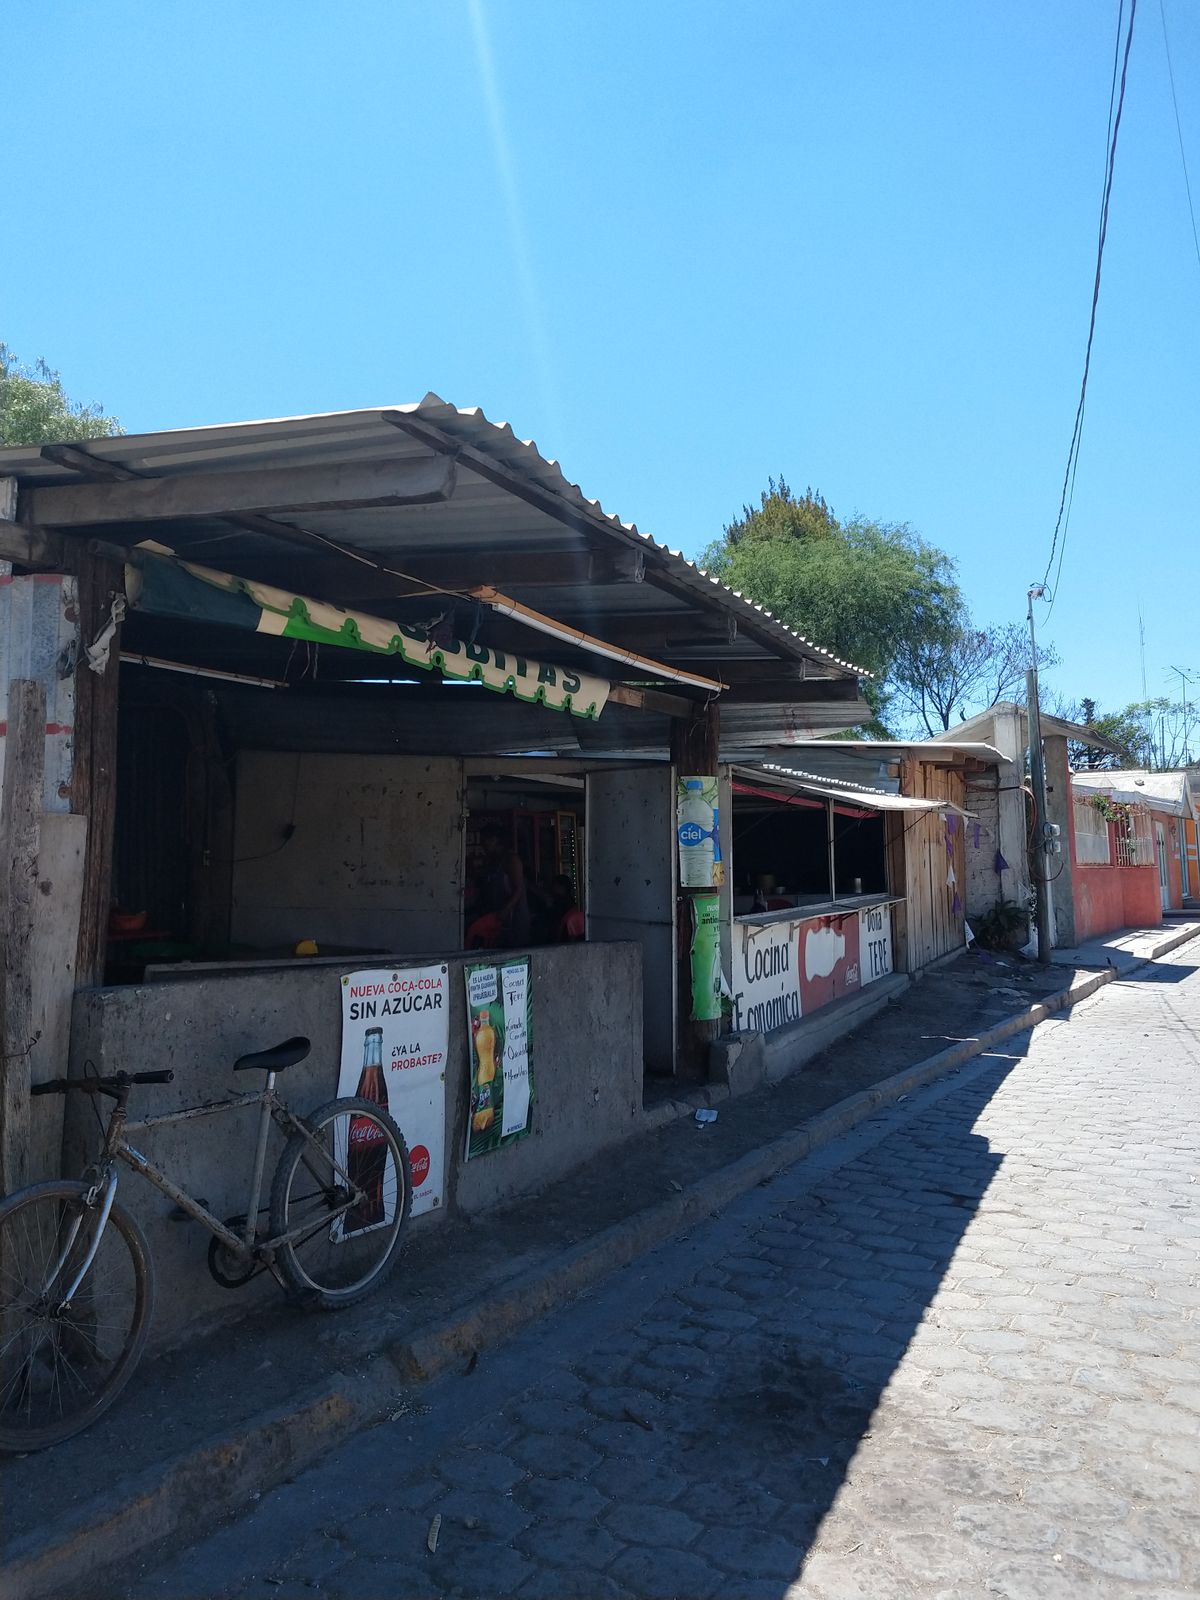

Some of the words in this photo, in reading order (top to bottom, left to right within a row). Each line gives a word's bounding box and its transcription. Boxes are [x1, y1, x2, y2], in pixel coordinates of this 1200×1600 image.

[681, 826, 702, 840] ciel
[744, 933, 789, 984] Cocina
[868, 938, 889, 978] TERE
[350, 983, 385, 998] NUEVA
[387, 978, 443, 994] COCA-COLA
[350, 999, 378, 1020] SIN
[381, 992, 443, 1017] AZÚCAR
[391, 1045, 407, 1057] ¿YA
[409, 1042, 421, 1053] LA
[391, 1053, 443, 1072] PROBASTE?
